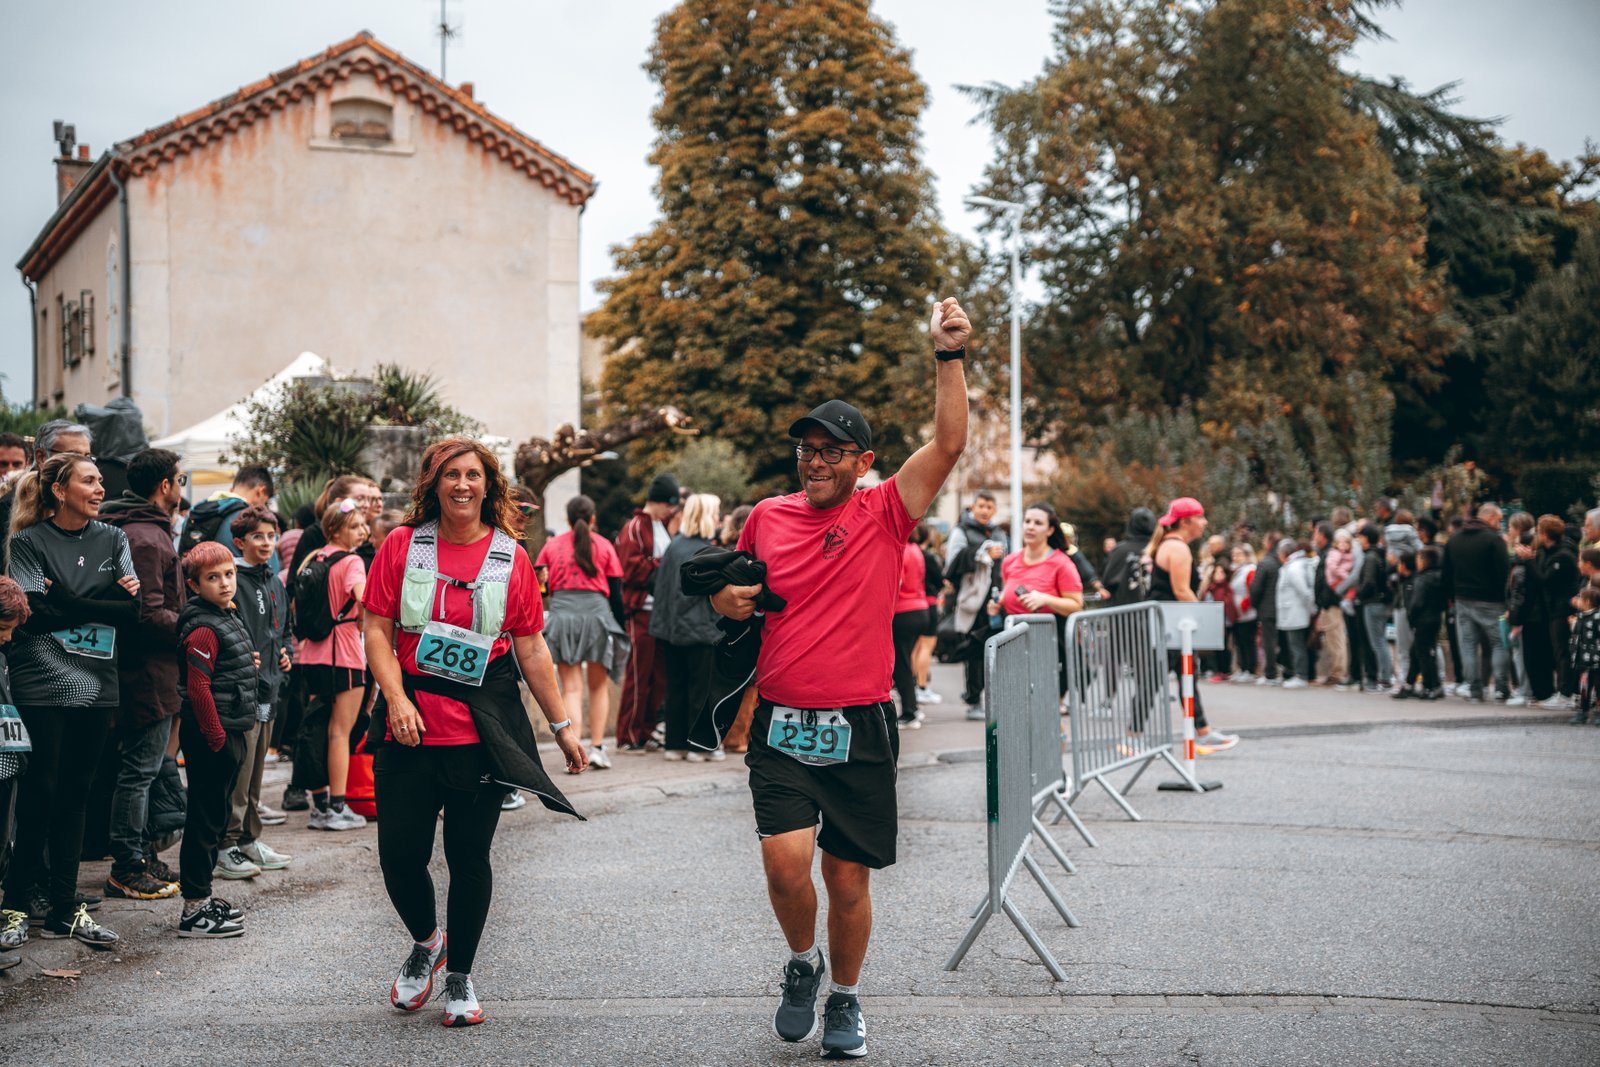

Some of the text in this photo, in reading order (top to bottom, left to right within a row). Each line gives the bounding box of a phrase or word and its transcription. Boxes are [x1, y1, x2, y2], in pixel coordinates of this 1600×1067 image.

[69, 625, 99, 647] 54
[423, 639, 478, 673] 268
[778, 725, 839, 754] 239
